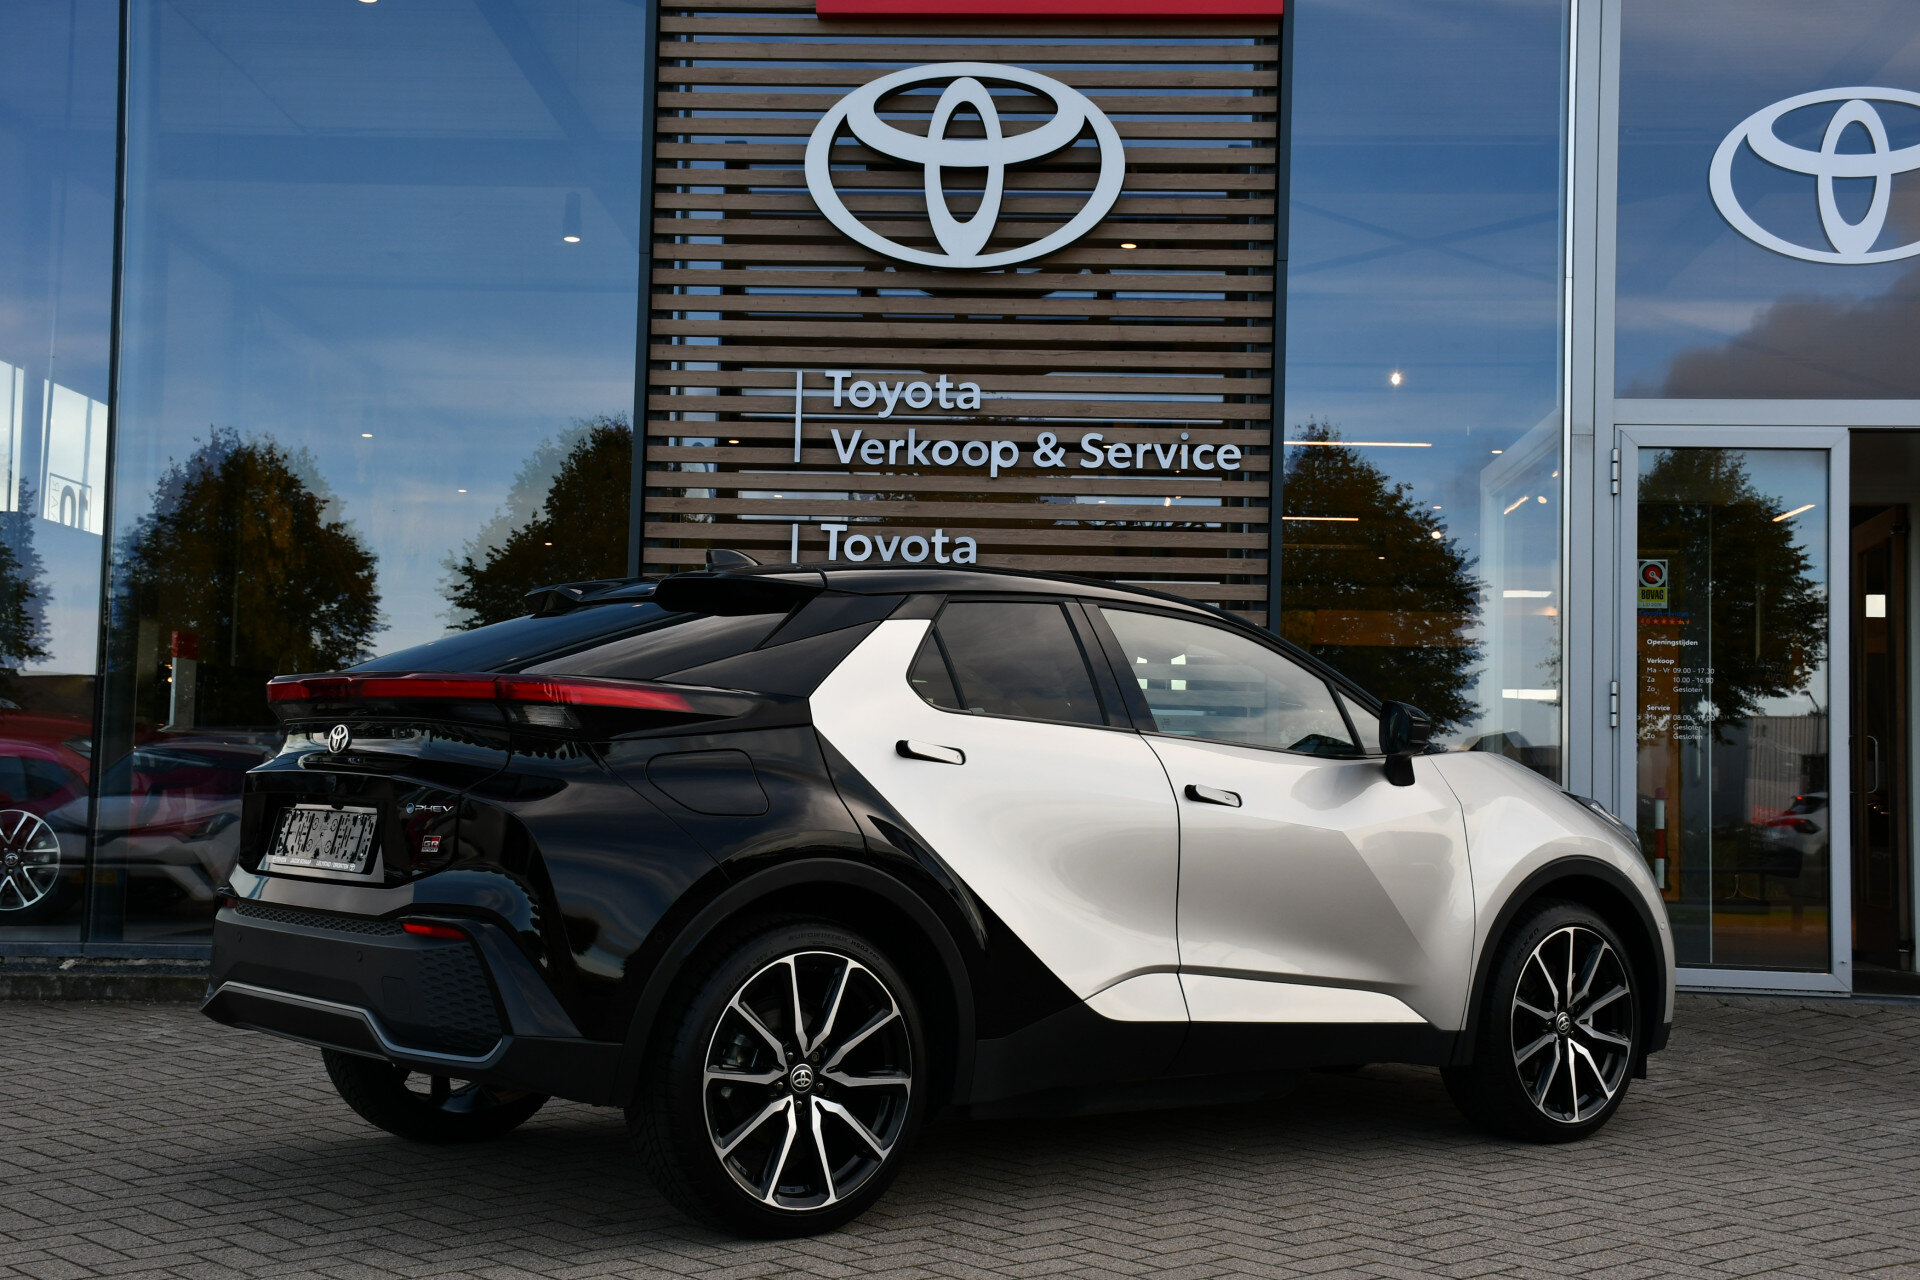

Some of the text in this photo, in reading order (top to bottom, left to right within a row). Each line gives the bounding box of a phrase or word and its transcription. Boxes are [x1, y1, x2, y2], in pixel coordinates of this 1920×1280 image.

[825, 370, 981, 419] Toyota
[831, 428, 1242, 478] Verkoop & Service
[1641, 589, 1664, 600] BOVAG
[1646, 638, 1699, 647] Openingstijden
[1646, 657, 1675, 665] Verkoop
[1672, 723, 1703, 731] Gesloten
[1672, 732, 1703, 740] Gesloten
[415, 804, 454, 813] PHEV
